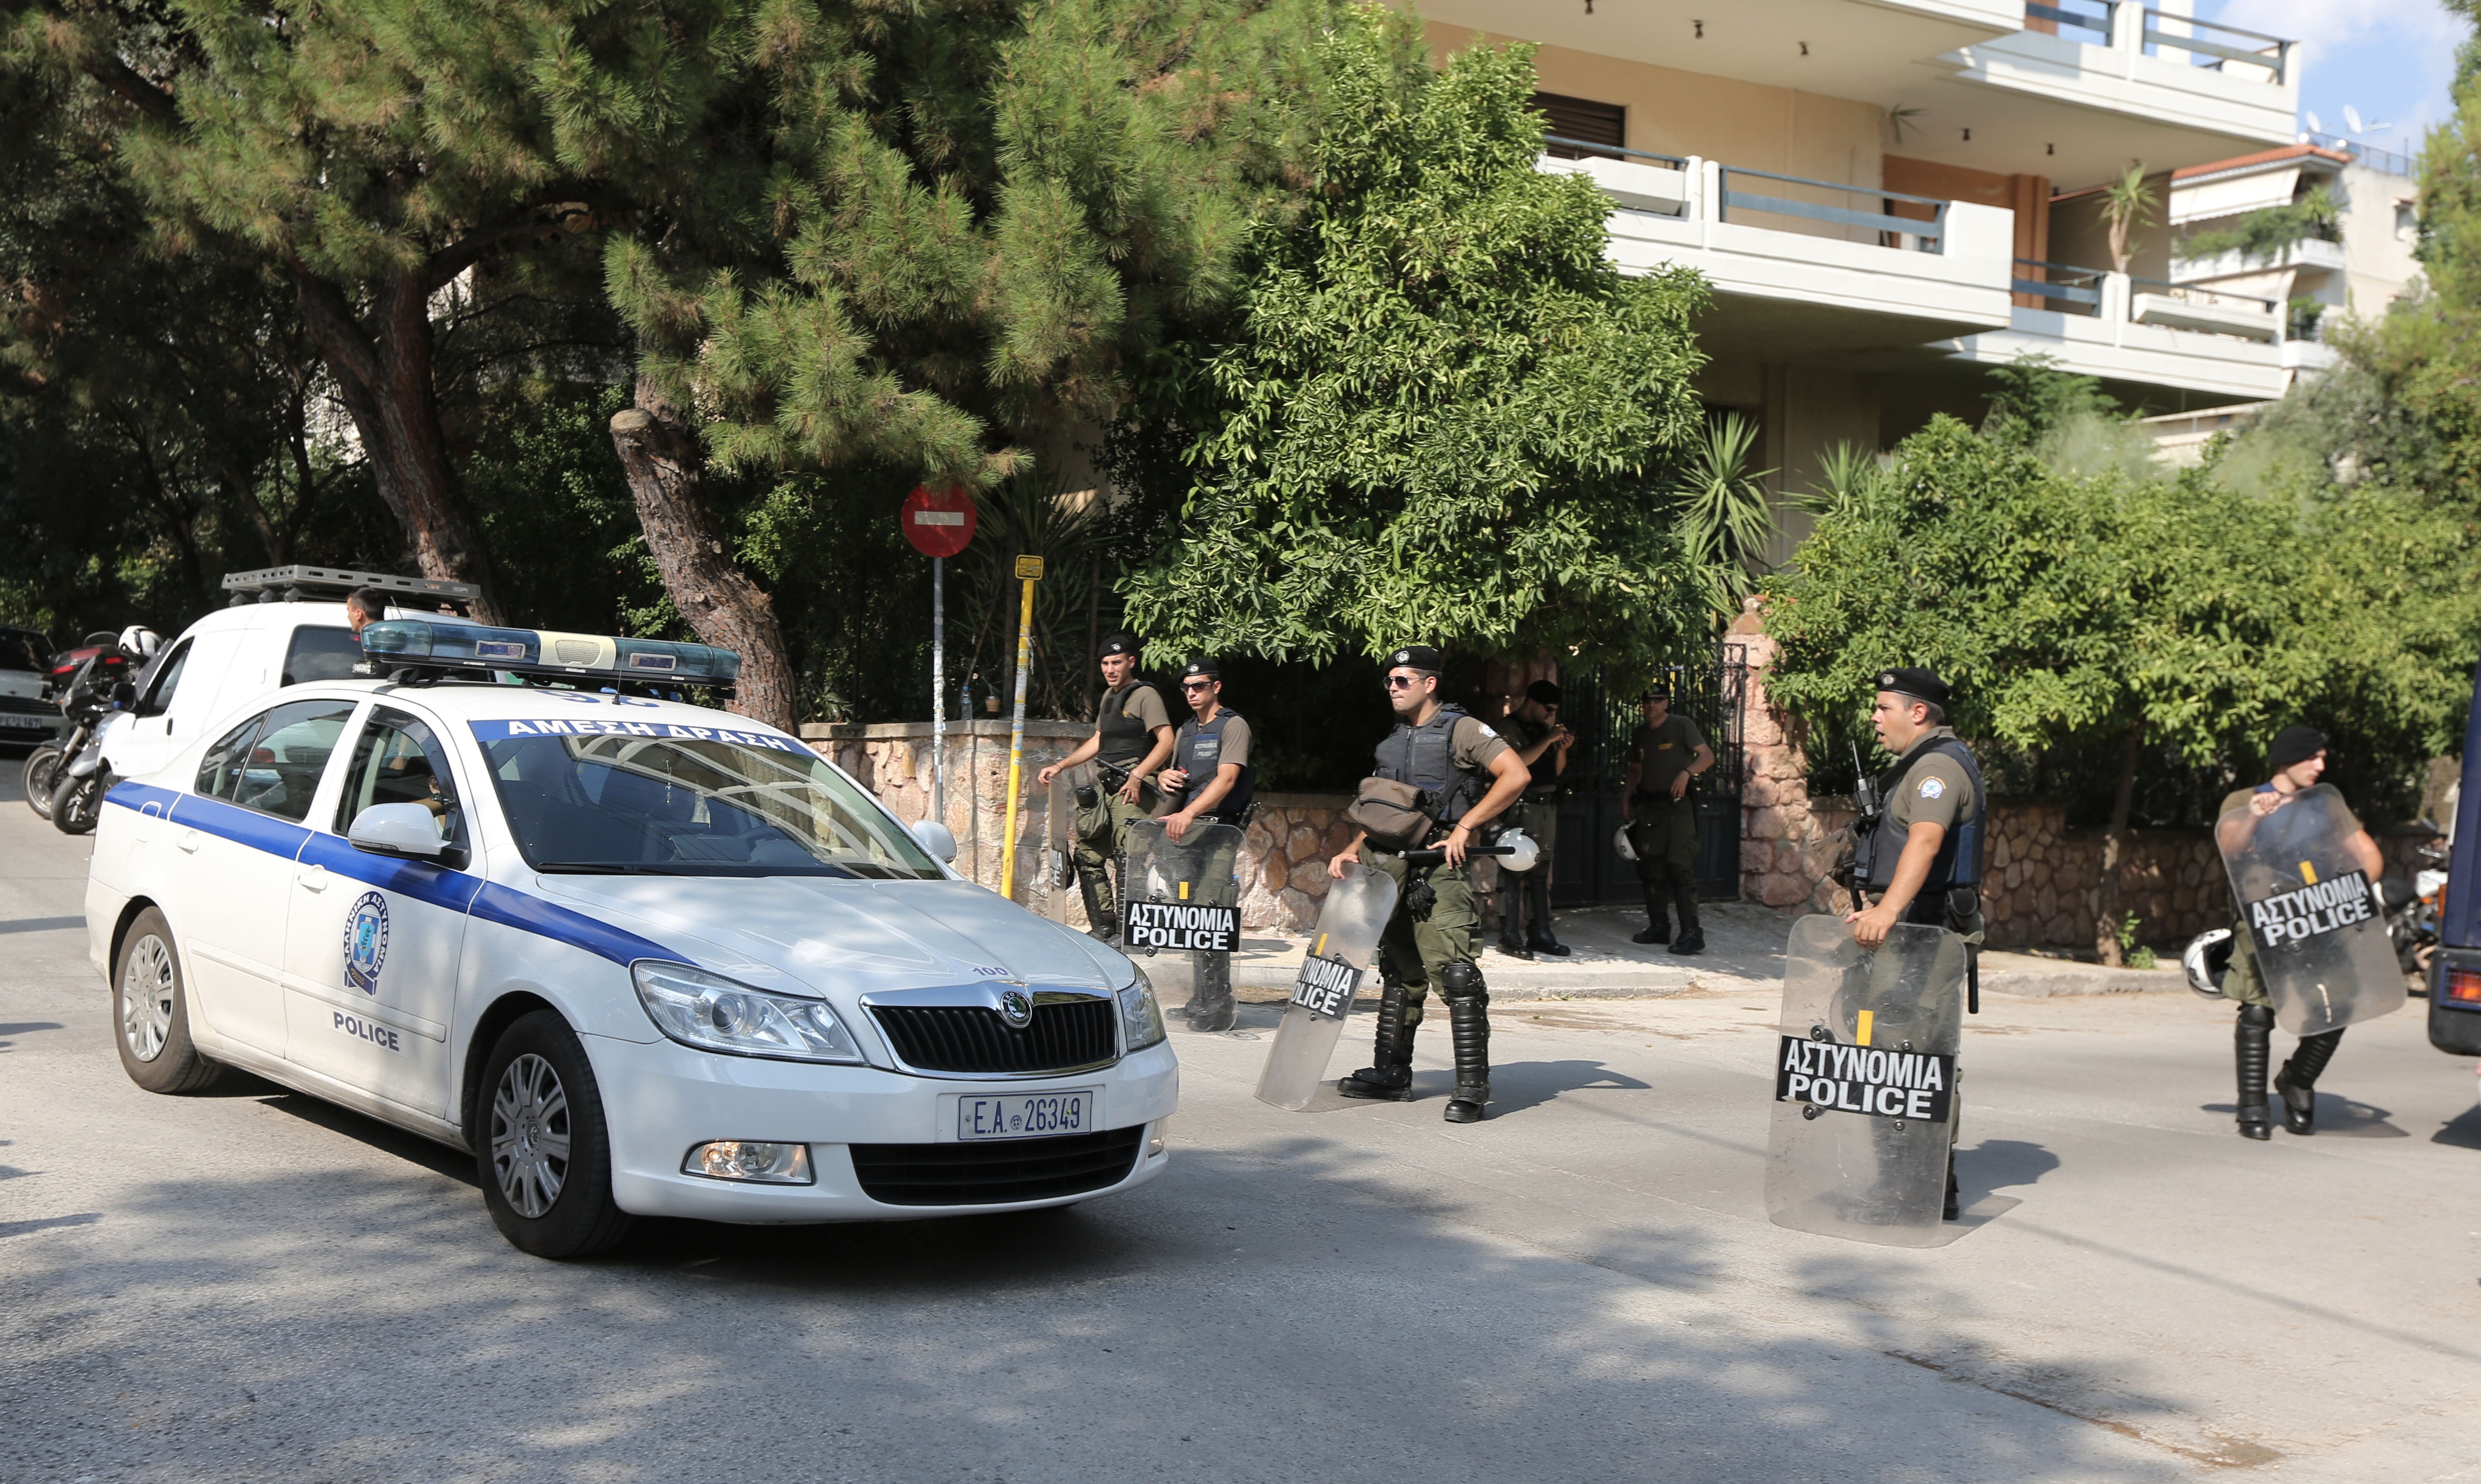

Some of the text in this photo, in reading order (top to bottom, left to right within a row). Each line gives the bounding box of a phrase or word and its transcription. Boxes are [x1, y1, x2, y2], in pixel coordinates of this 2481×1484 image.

[509, 720, 792, 752] ΑΜΕΣΗ ΔΡΑΣΗ
[1129, 903, 1234, 932] ΑΣΤΥΝΟΜΙΑ
[2252, 872, 2369, 929] ΑΣΤΥΝΟΜΙΑ
[344, 894, 388, 973] ΕΛΛΗΝΙΚΗ ΑΣΤΥΝΟΜΙΑ
[1133, 926, 1229, 950] POLICE
[2263, 897, 2371, 947] POLICE
[973, 967, 1009, 976] 100
[1290, 982, 1341, 1016] OLICE
[333, 1011, 400, 1051] POLICE
[1784, 1039, 1943, 1091] ΑΣΤΥΝΟΜΙΑ
[1025, 1097, 1080, 1131] 26349
[1788, 1073, 1933, 1119] POLICE
